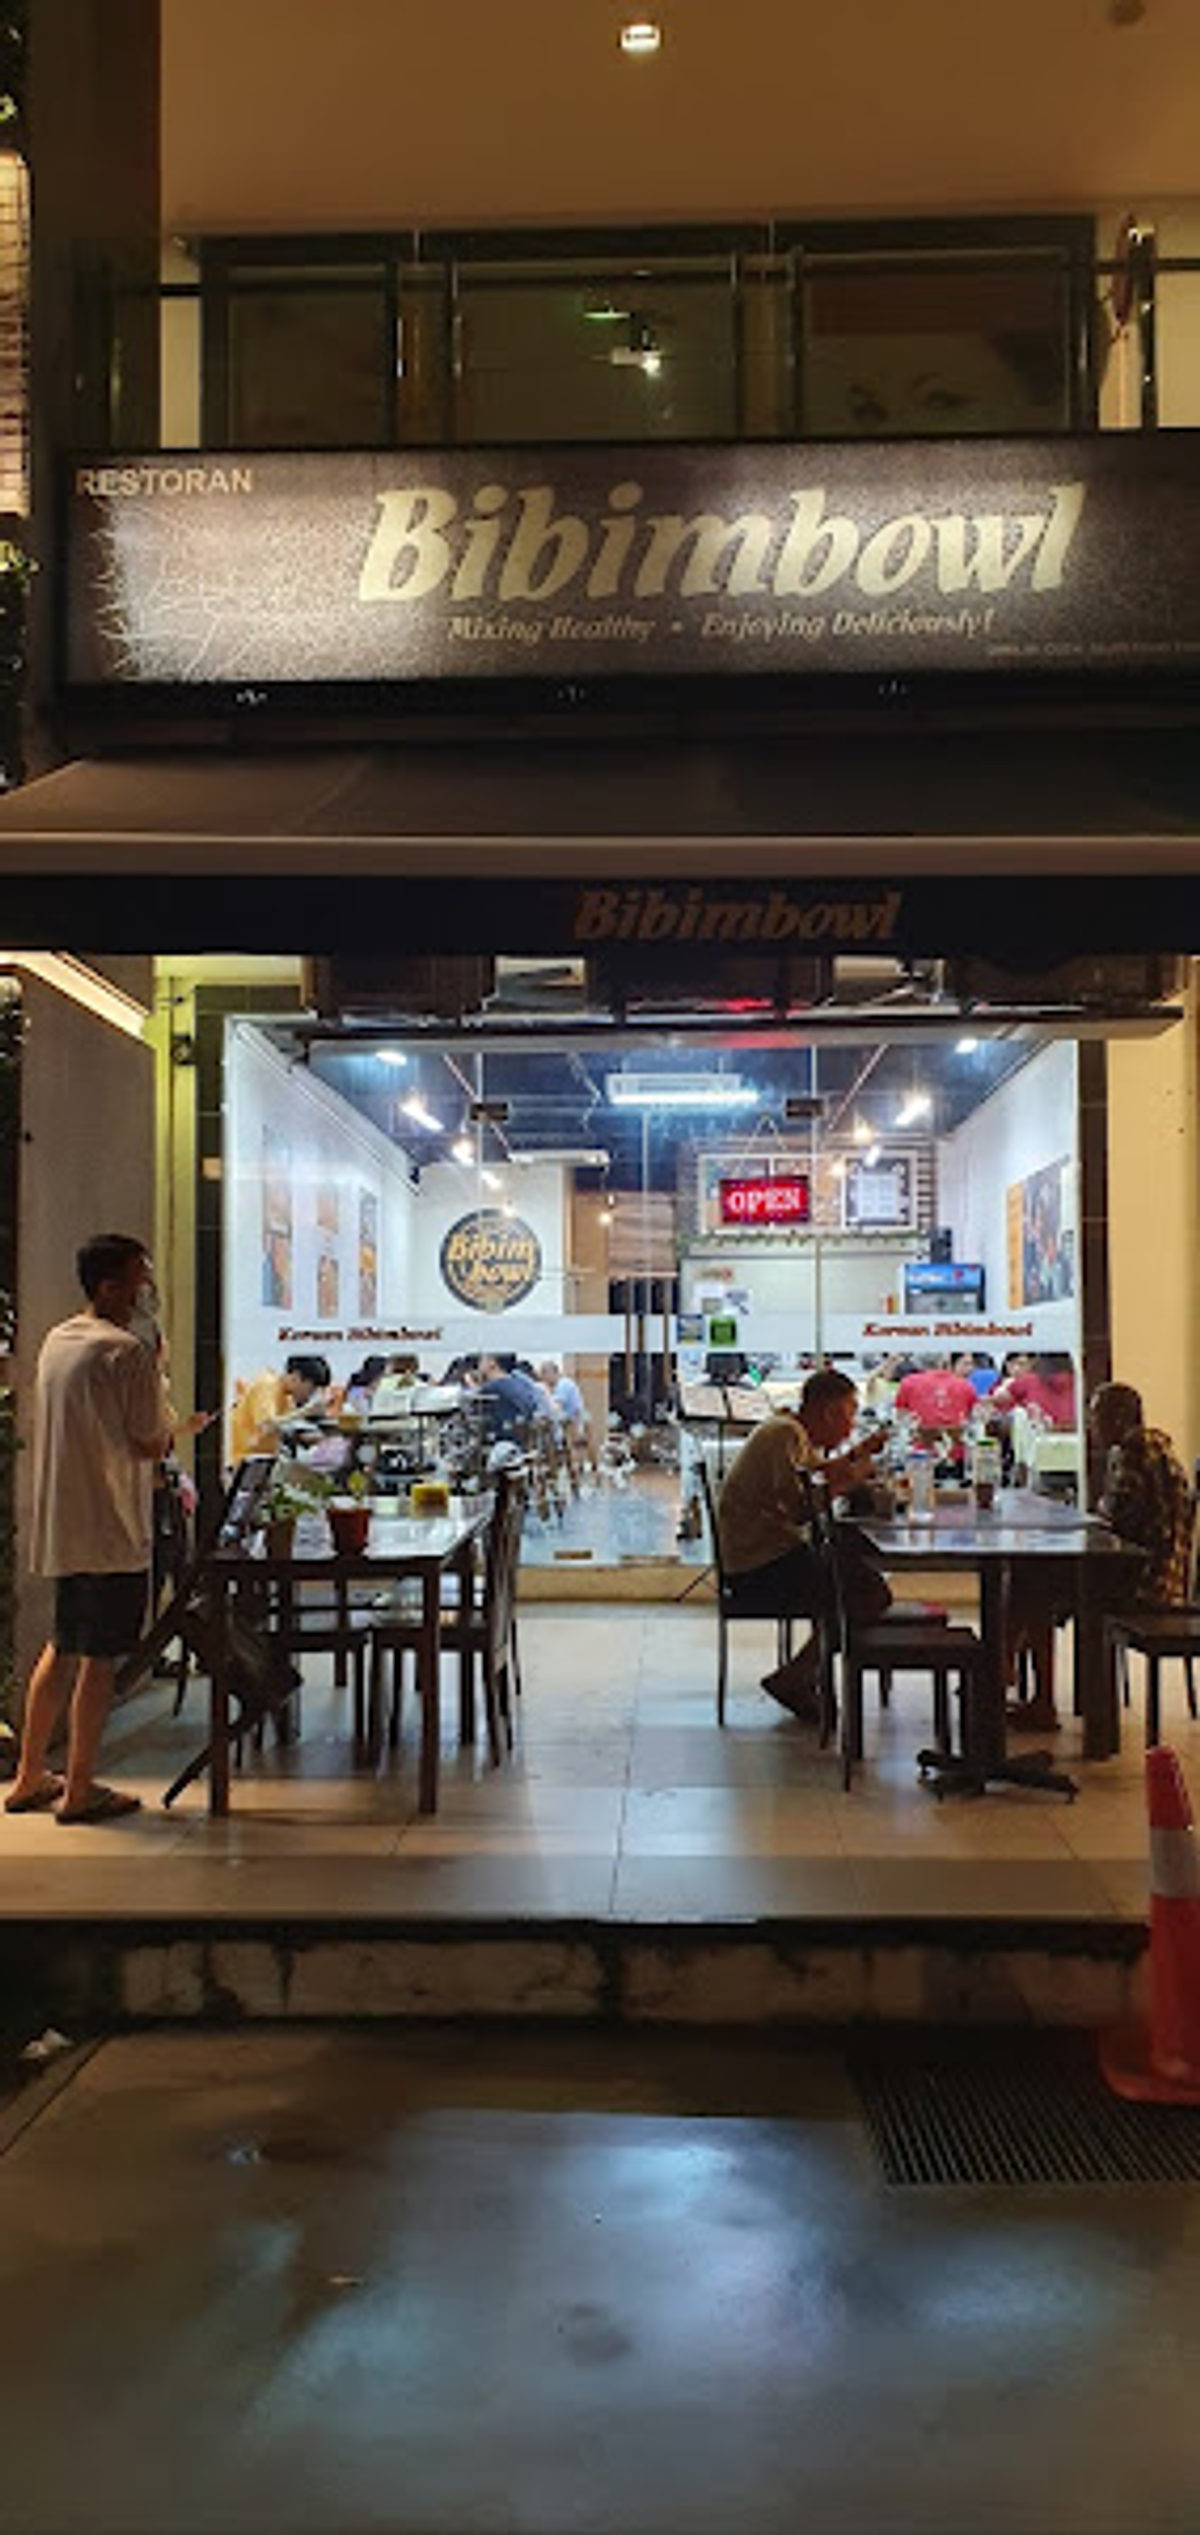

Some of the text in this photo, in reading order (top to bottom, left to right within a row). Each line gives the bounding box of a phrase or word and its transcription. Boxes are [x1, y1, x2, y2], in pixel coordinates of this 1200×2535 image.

[76, 469, 253, 496] RESTORAN
[360, 483, 1084, 601] Bibimbowl
[447, 608, 995, 643] Mixing Healthy Enjoying Deliciously!
[573, 888, 902, 940] Bibimbowl
[728, 1187, 801, 1214] OPEN
